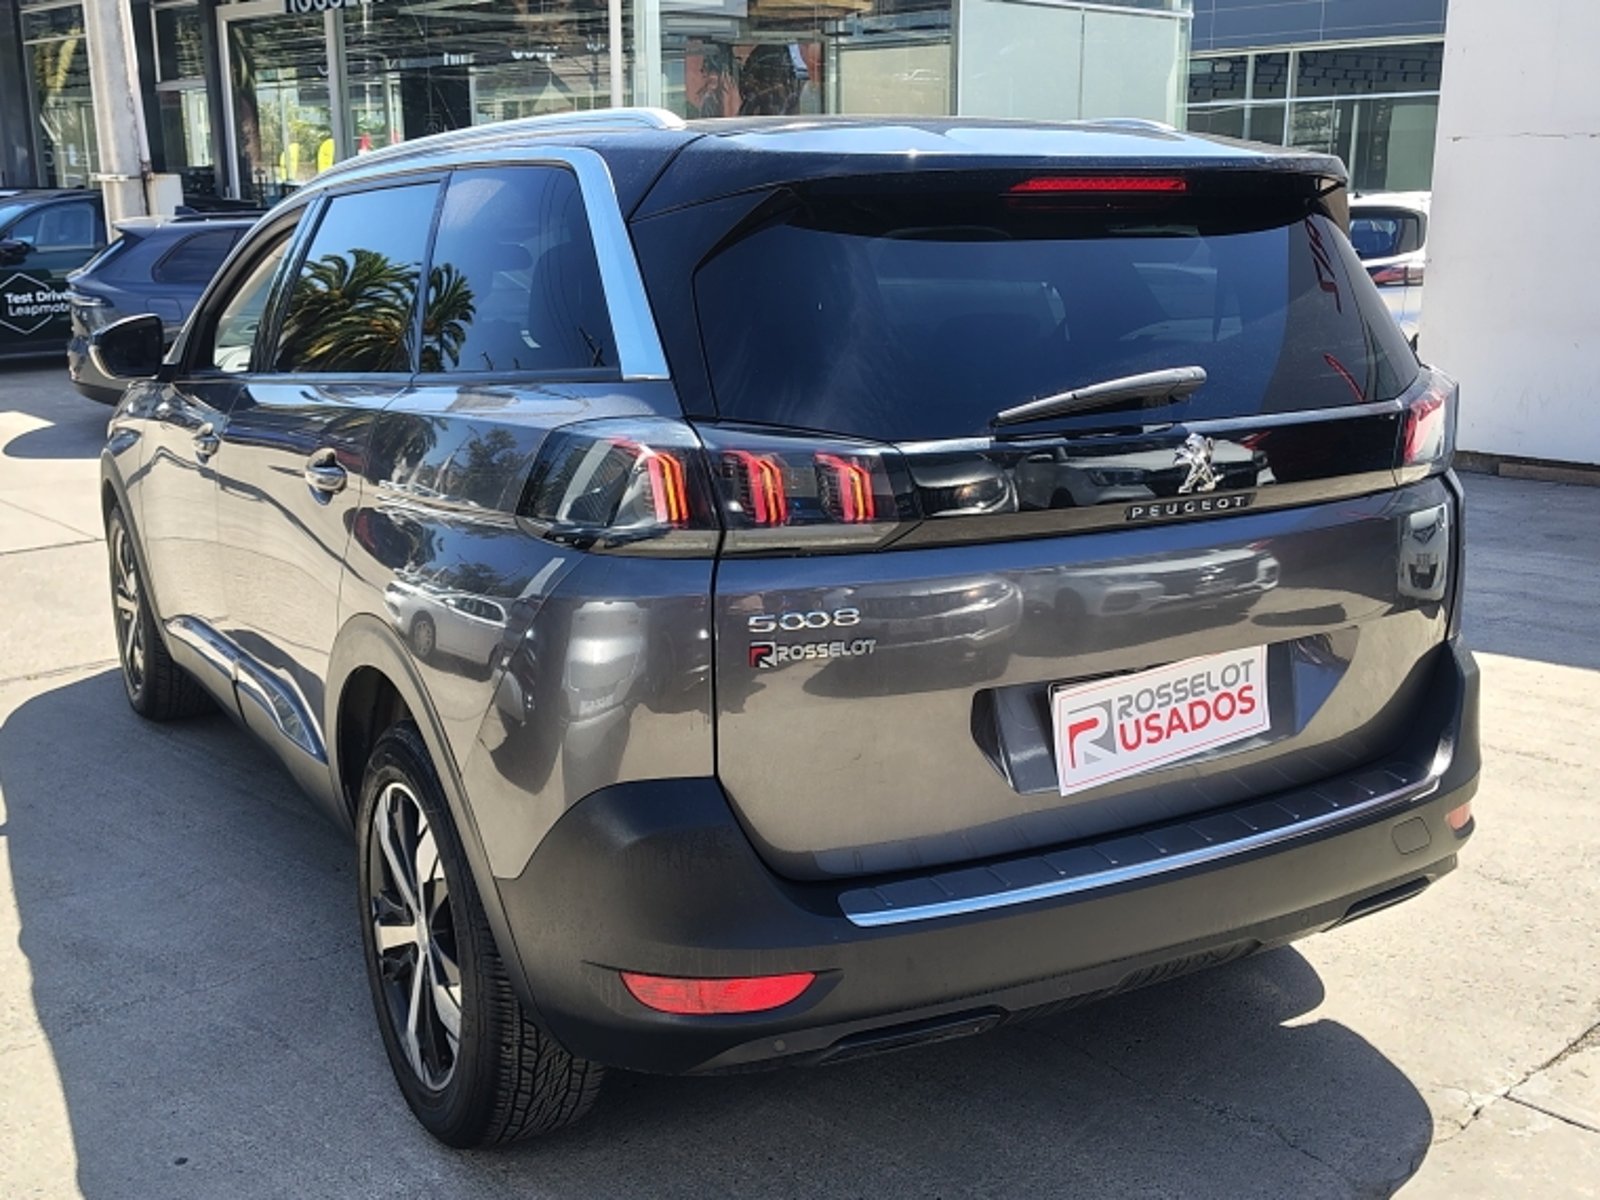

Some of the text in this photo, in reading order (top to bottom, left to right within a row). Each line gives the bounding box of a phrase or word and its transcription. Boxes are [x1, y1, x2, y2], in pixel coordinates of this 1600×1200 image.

[4, 289, 70, 304] Test Drive
[1131, 496, 1245, 518] PEUGEOT
[748, 607, 861, 633] 5008
[777, 639, 877, 662] ROSSELOT
[1116, 658, 1255, 721] ROSSELOT
[1118, 684, 1257, 751] USADOS
